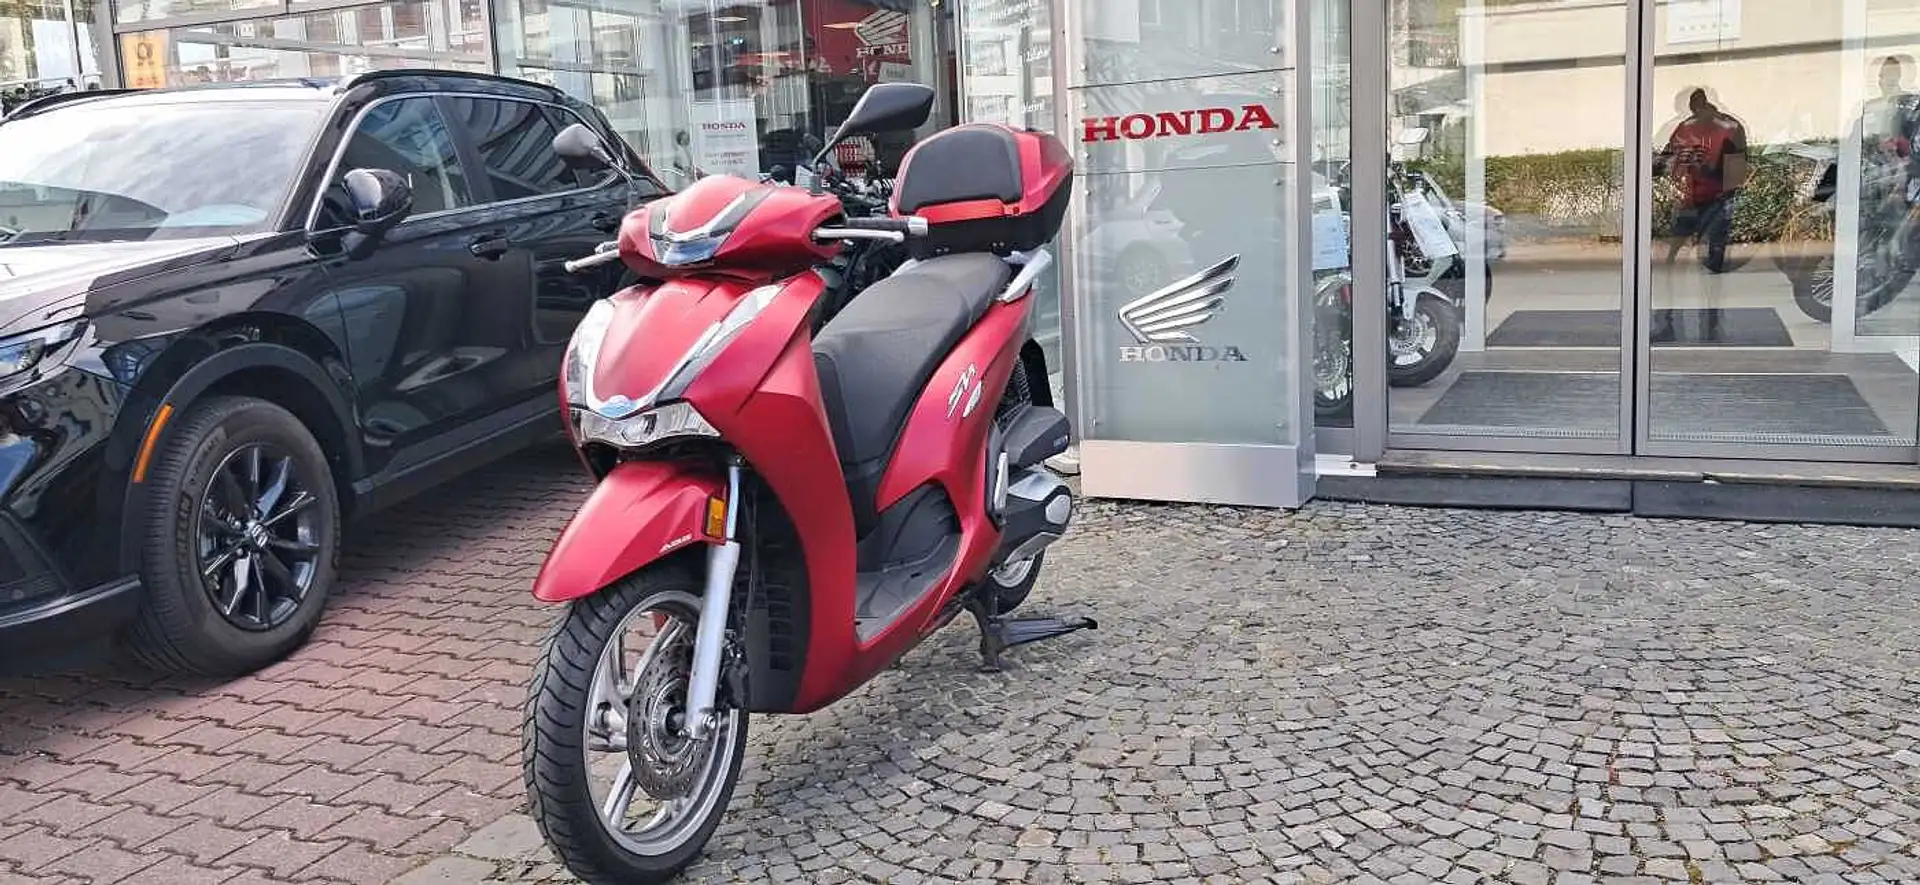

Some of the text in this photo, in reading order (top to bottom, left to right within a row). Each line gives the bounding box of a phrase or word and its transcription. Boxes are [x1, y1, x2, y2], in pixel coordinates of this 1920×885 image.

[702, 122, 746, 130] HONDA
[1080, 102, 1279, 143] HONDA
[1118, 345, 1249, 362] HONDA
